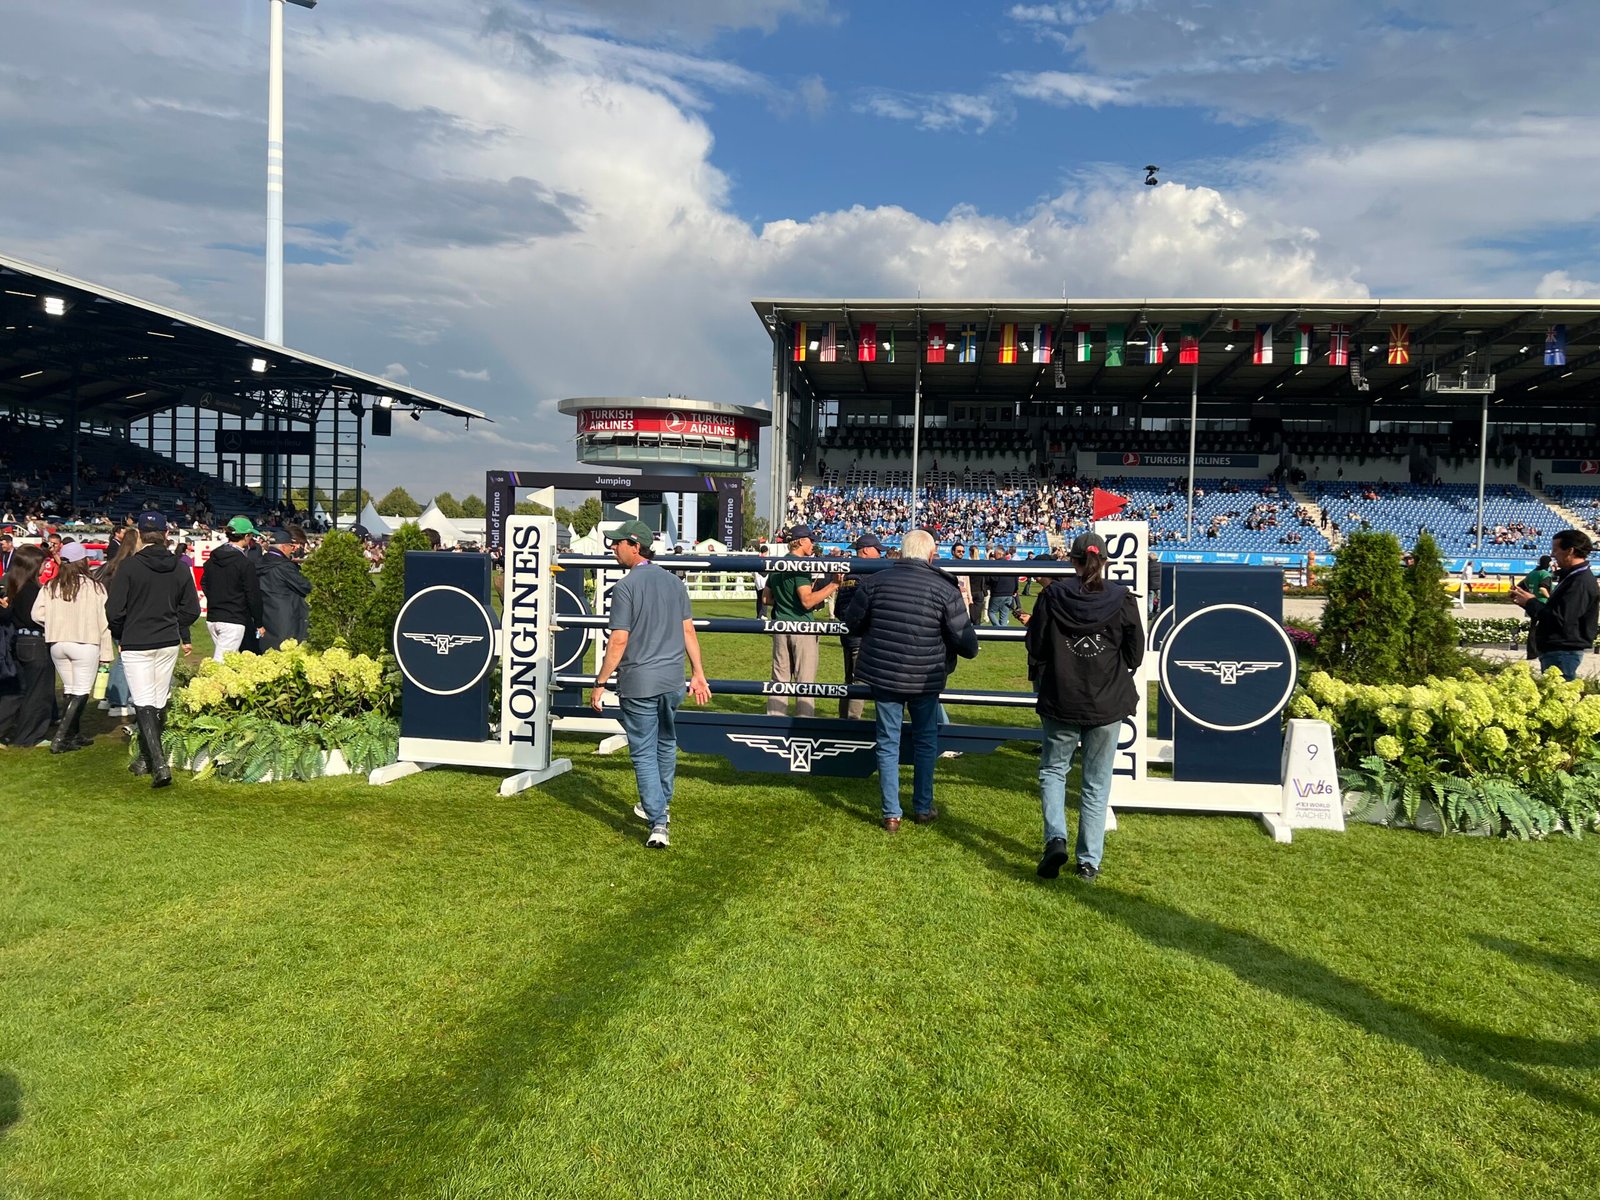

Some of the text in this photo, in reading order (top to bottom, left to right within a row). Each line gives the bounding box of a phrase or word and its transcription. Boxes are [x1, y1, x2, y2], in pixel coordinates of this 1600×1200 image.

[590, 409, 634, 420] TURKISH
[690, 412, 735, 426] TURKISH
[589, 419, 635, 431] AIRLINES
[690, 423, 736, 437] AIRLINES
[1144, 456, 1186, 465] TURKISH
[595, 475, 632, 488] Jumping
[725, 497, 735, 524] Fame
[491, 491, 501, 548] Hall of Fame
[724, 524, 734, 535] of
[764, 559, 851, 573] LONGINES
[763, 620, 850, 635] LONGINES
[509, 525, 541, 747] LONGINES
[762, 681, 848, 697] LONGINES
[1307, 744, 1319, 761] 9
[1295, 811, 1331, 820] AACHEN
